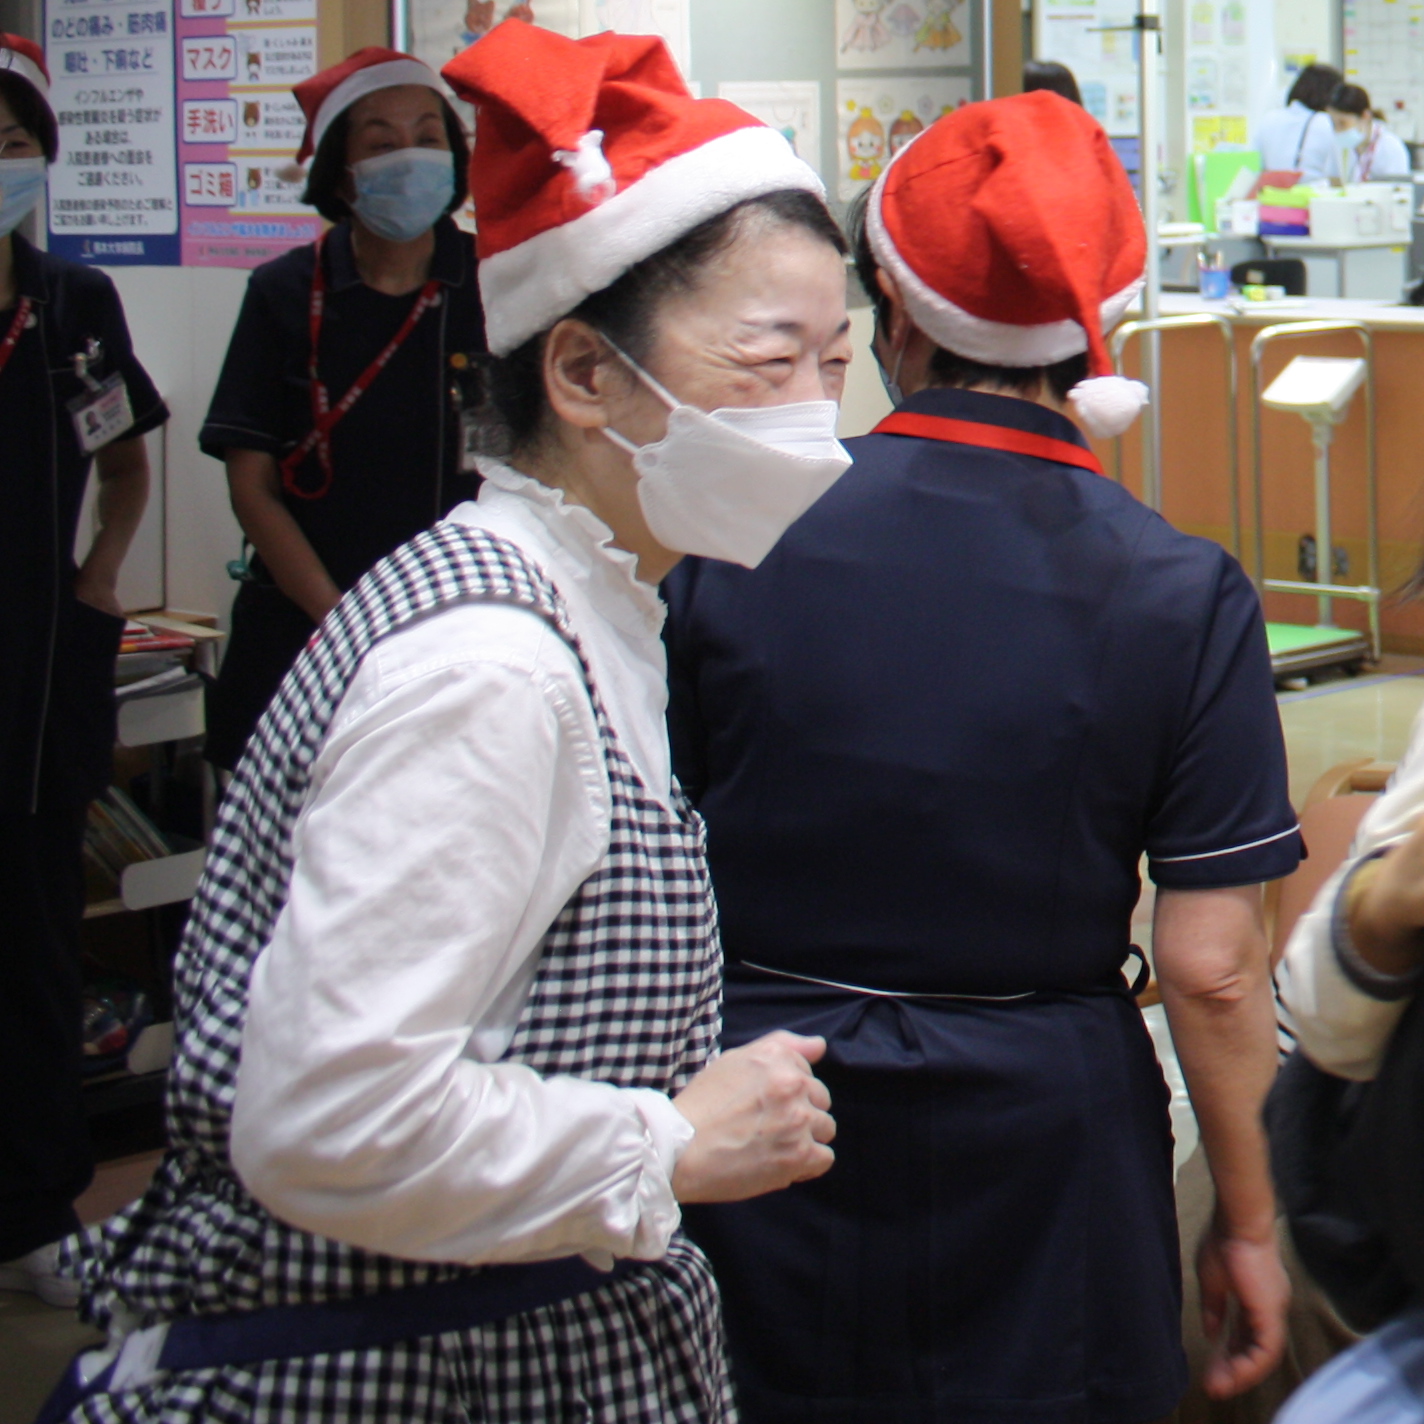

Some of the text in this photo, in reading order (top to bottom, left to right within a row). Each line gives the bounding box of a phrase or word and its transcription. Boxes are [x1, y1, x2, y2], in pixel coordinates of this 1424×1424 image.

[187, 46, 232, 71] マスク
[187, 108, 234, 135] 手洗い
